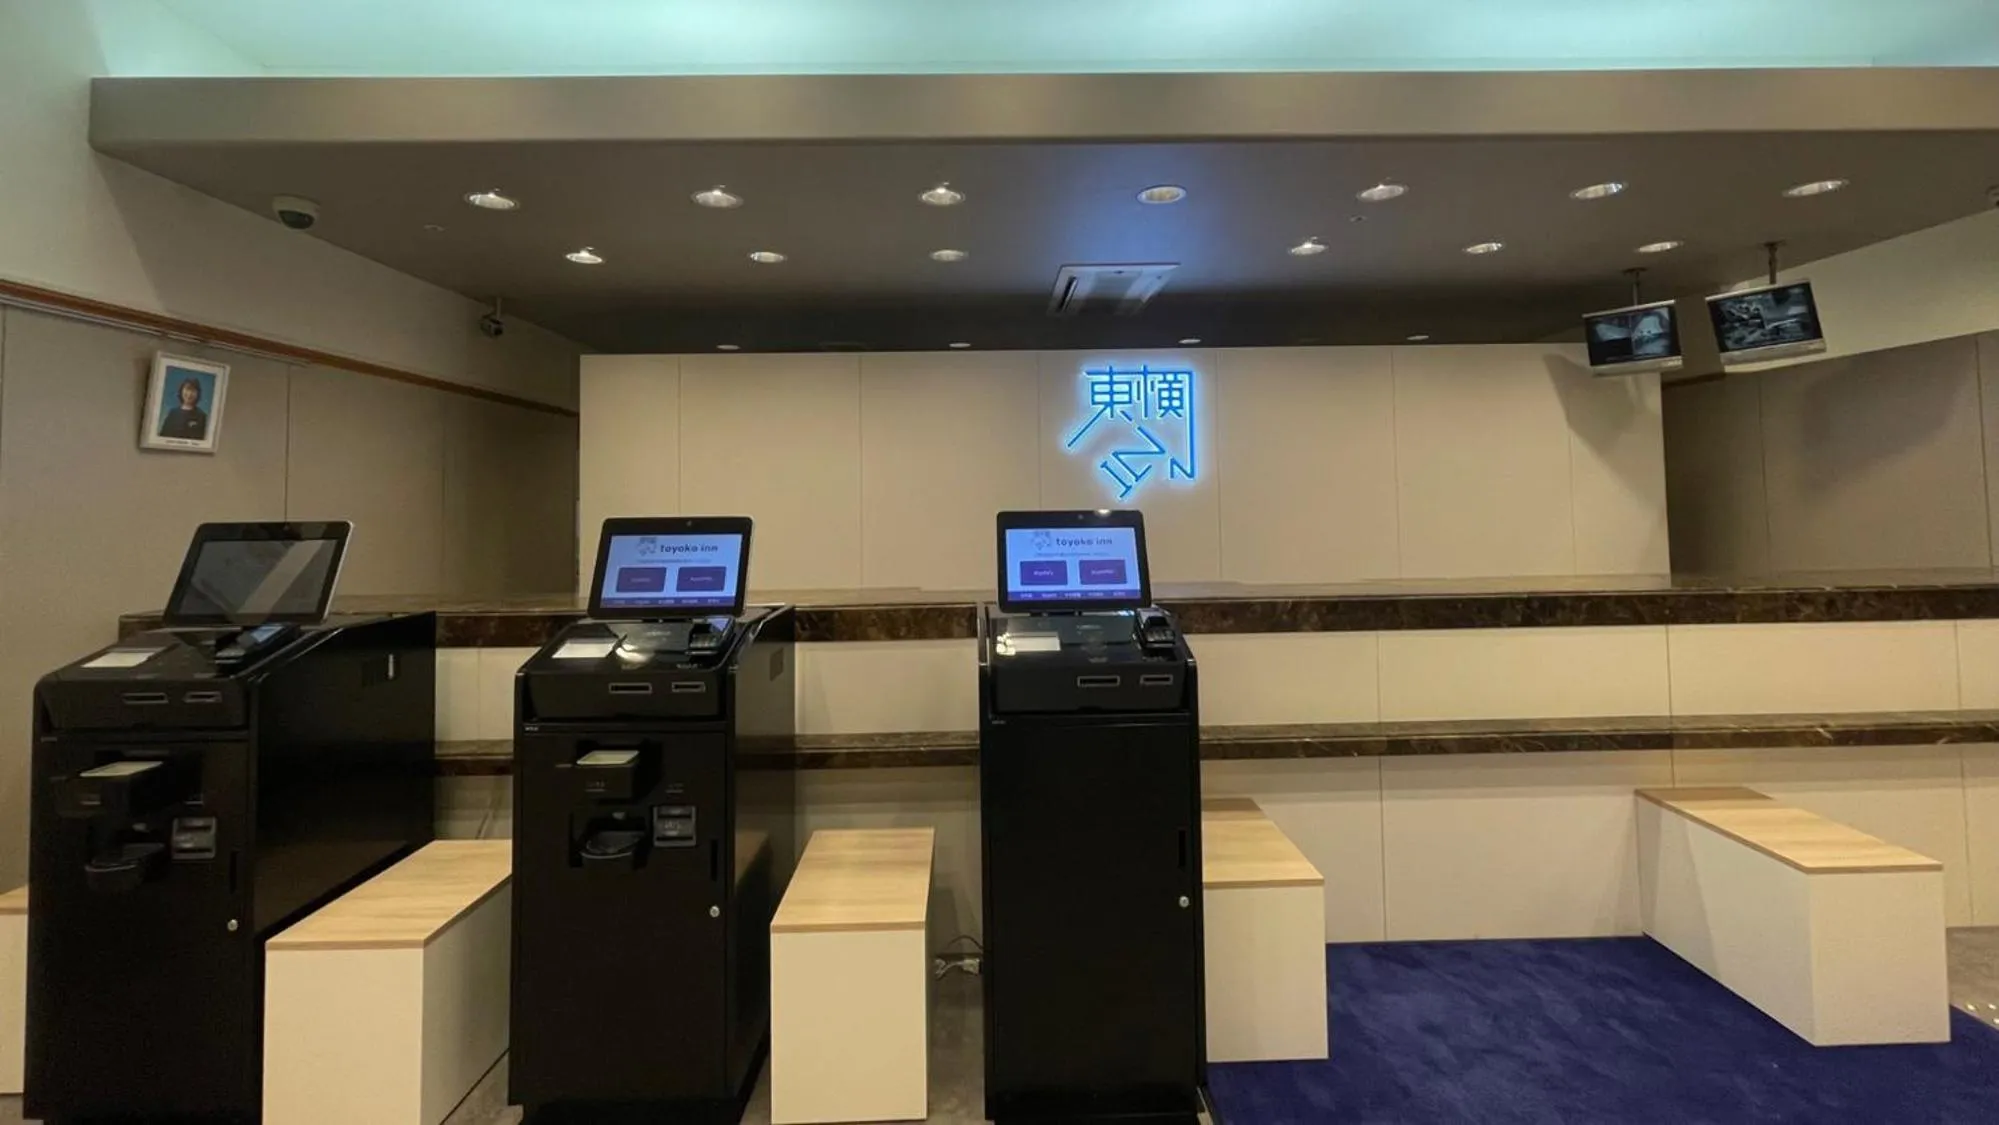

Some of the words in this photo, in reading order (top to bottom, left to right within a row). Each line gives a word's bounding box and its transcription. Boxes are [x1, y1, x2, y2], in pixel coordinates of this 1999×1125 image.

[1077, 364, 1194, 425] 東横
[1056, 537, 1094, 548] toyoko
[1096, 536, 1113, 545] inn
[660, 544, 698, 555] toyoko
[701, 544, 719, 553] inn
